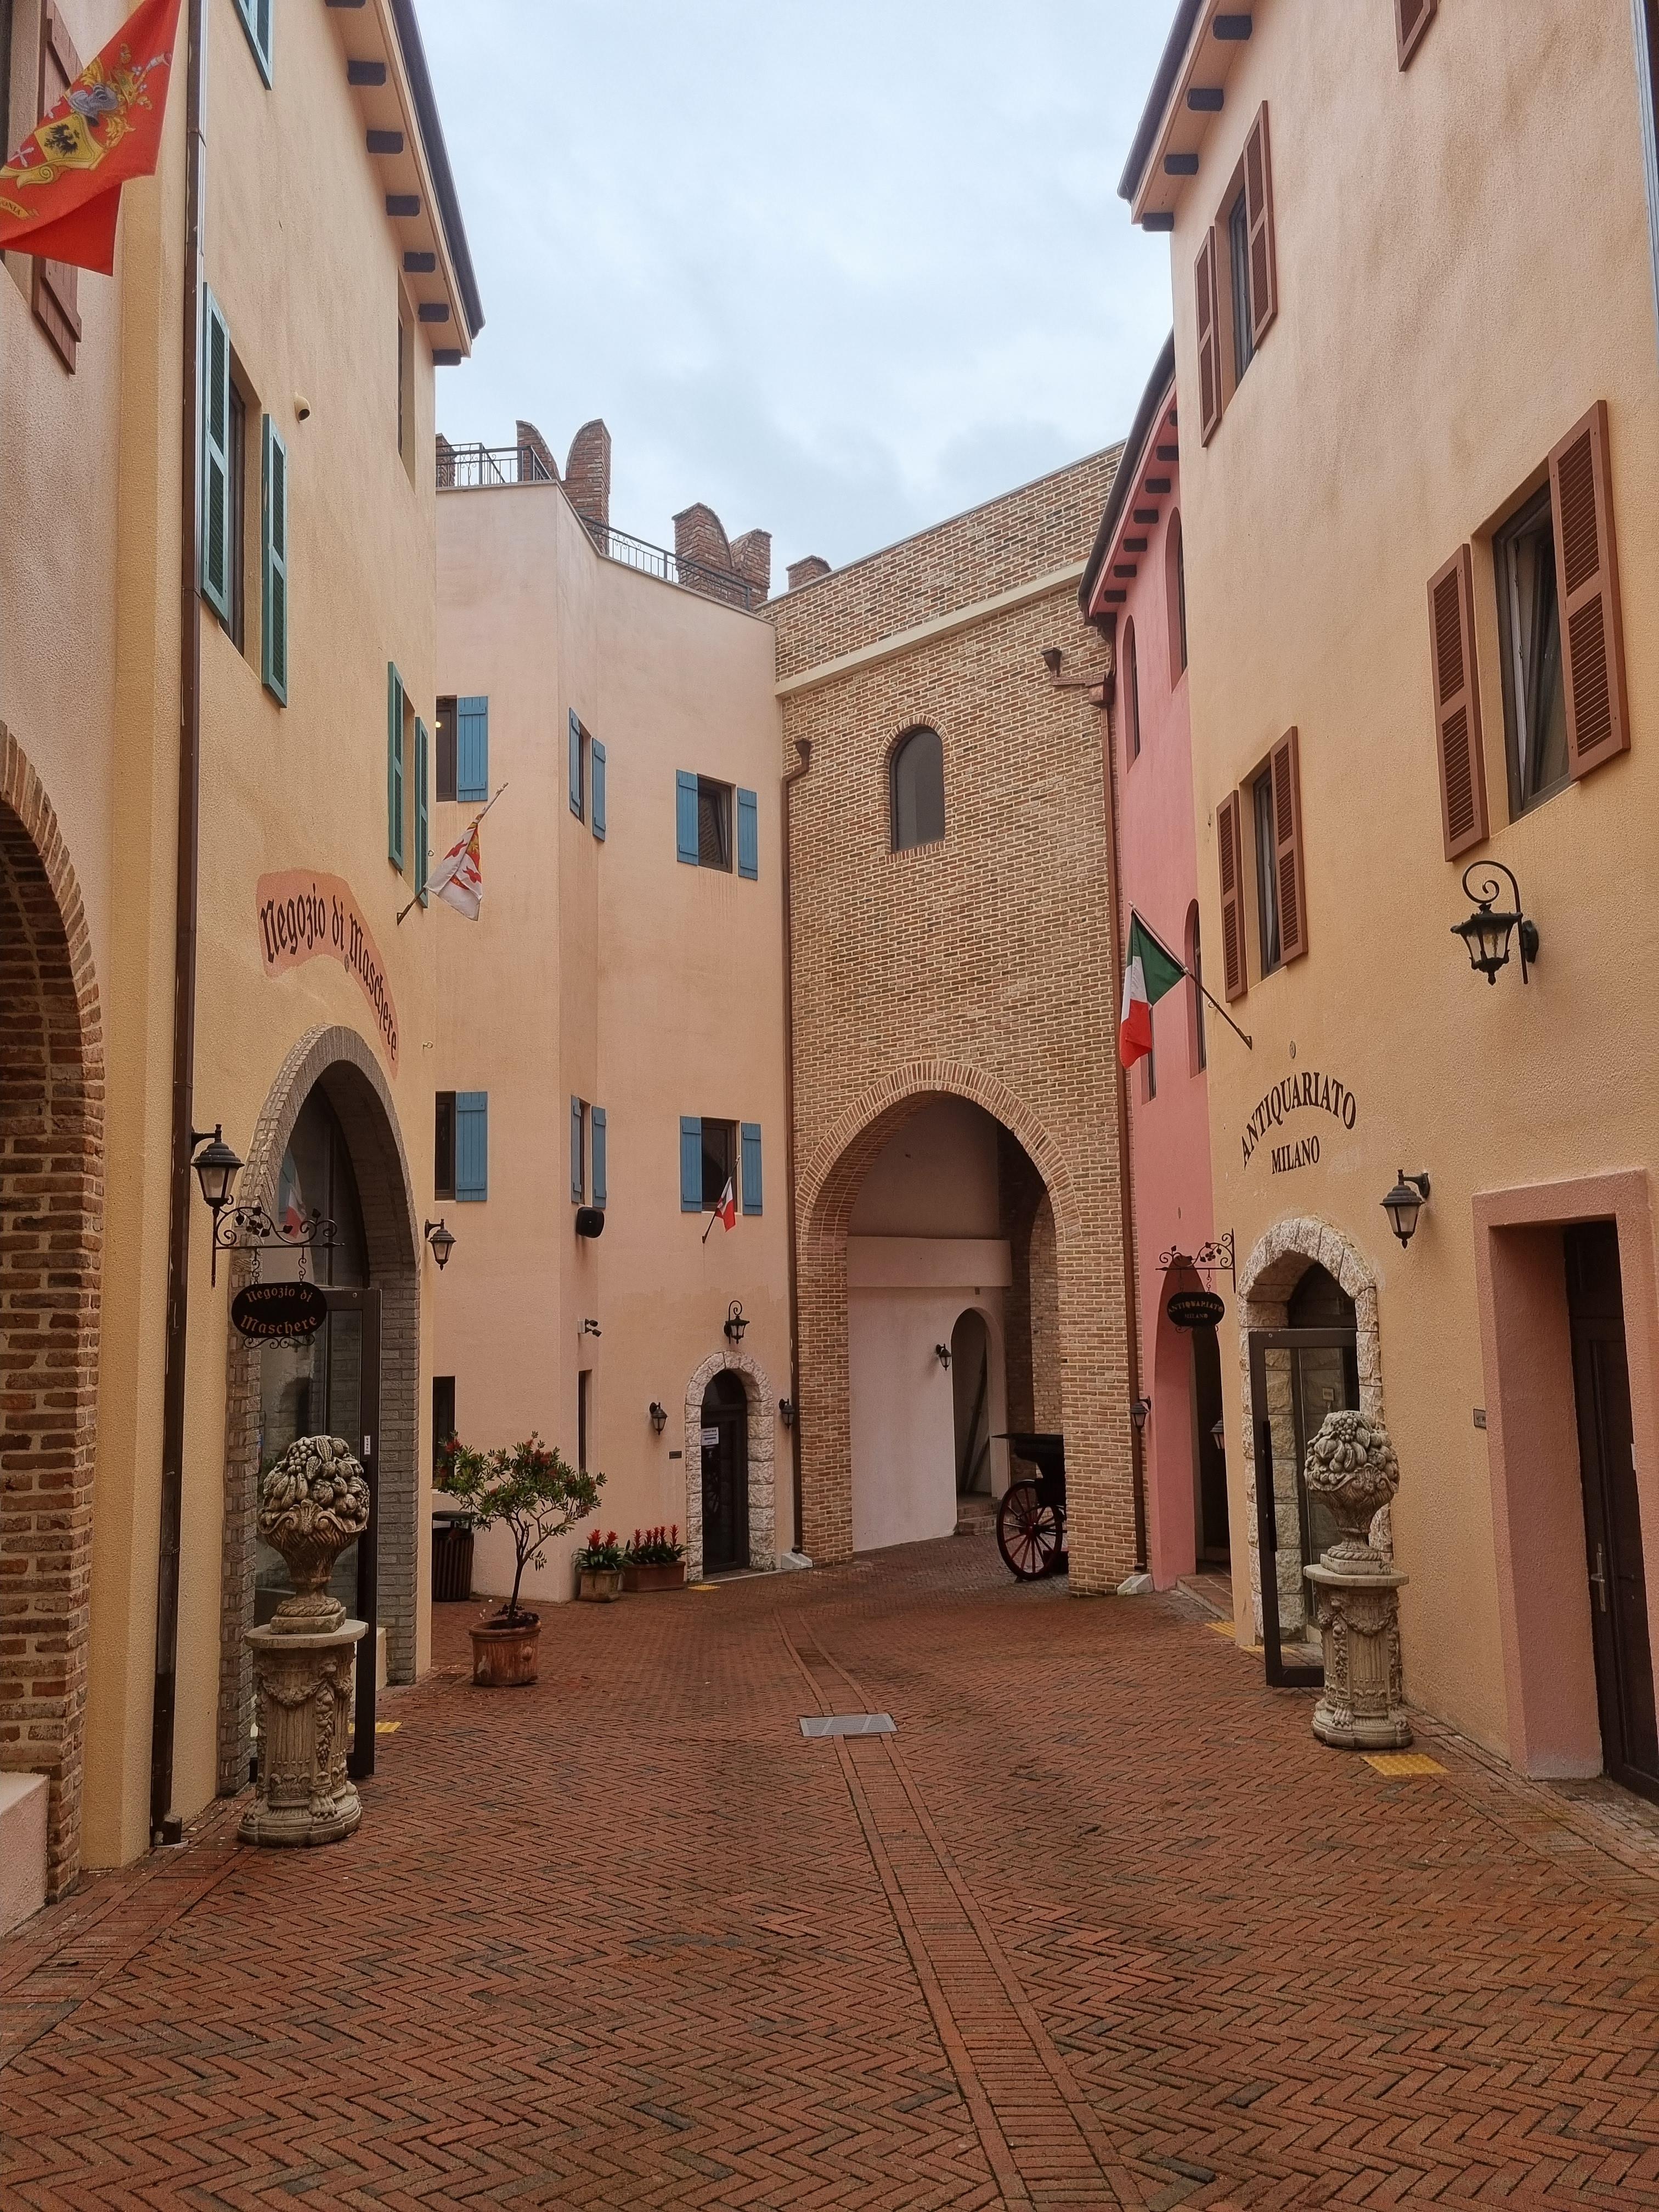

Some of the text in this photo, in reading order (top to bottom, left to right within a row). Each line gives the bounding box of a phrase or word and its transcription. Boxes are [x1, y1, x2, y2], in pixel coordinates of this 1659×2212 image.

[260, 883, 397, 1061] Negozio di Maschere
[1242, 1071, 1356, 1171] ANTIQUARIATO
[1271, 1135, 1320, 1175] MILANO
[246, 1285, 313, 1303] Negozio di
[240, 1314, 317, 1336] Maschere
